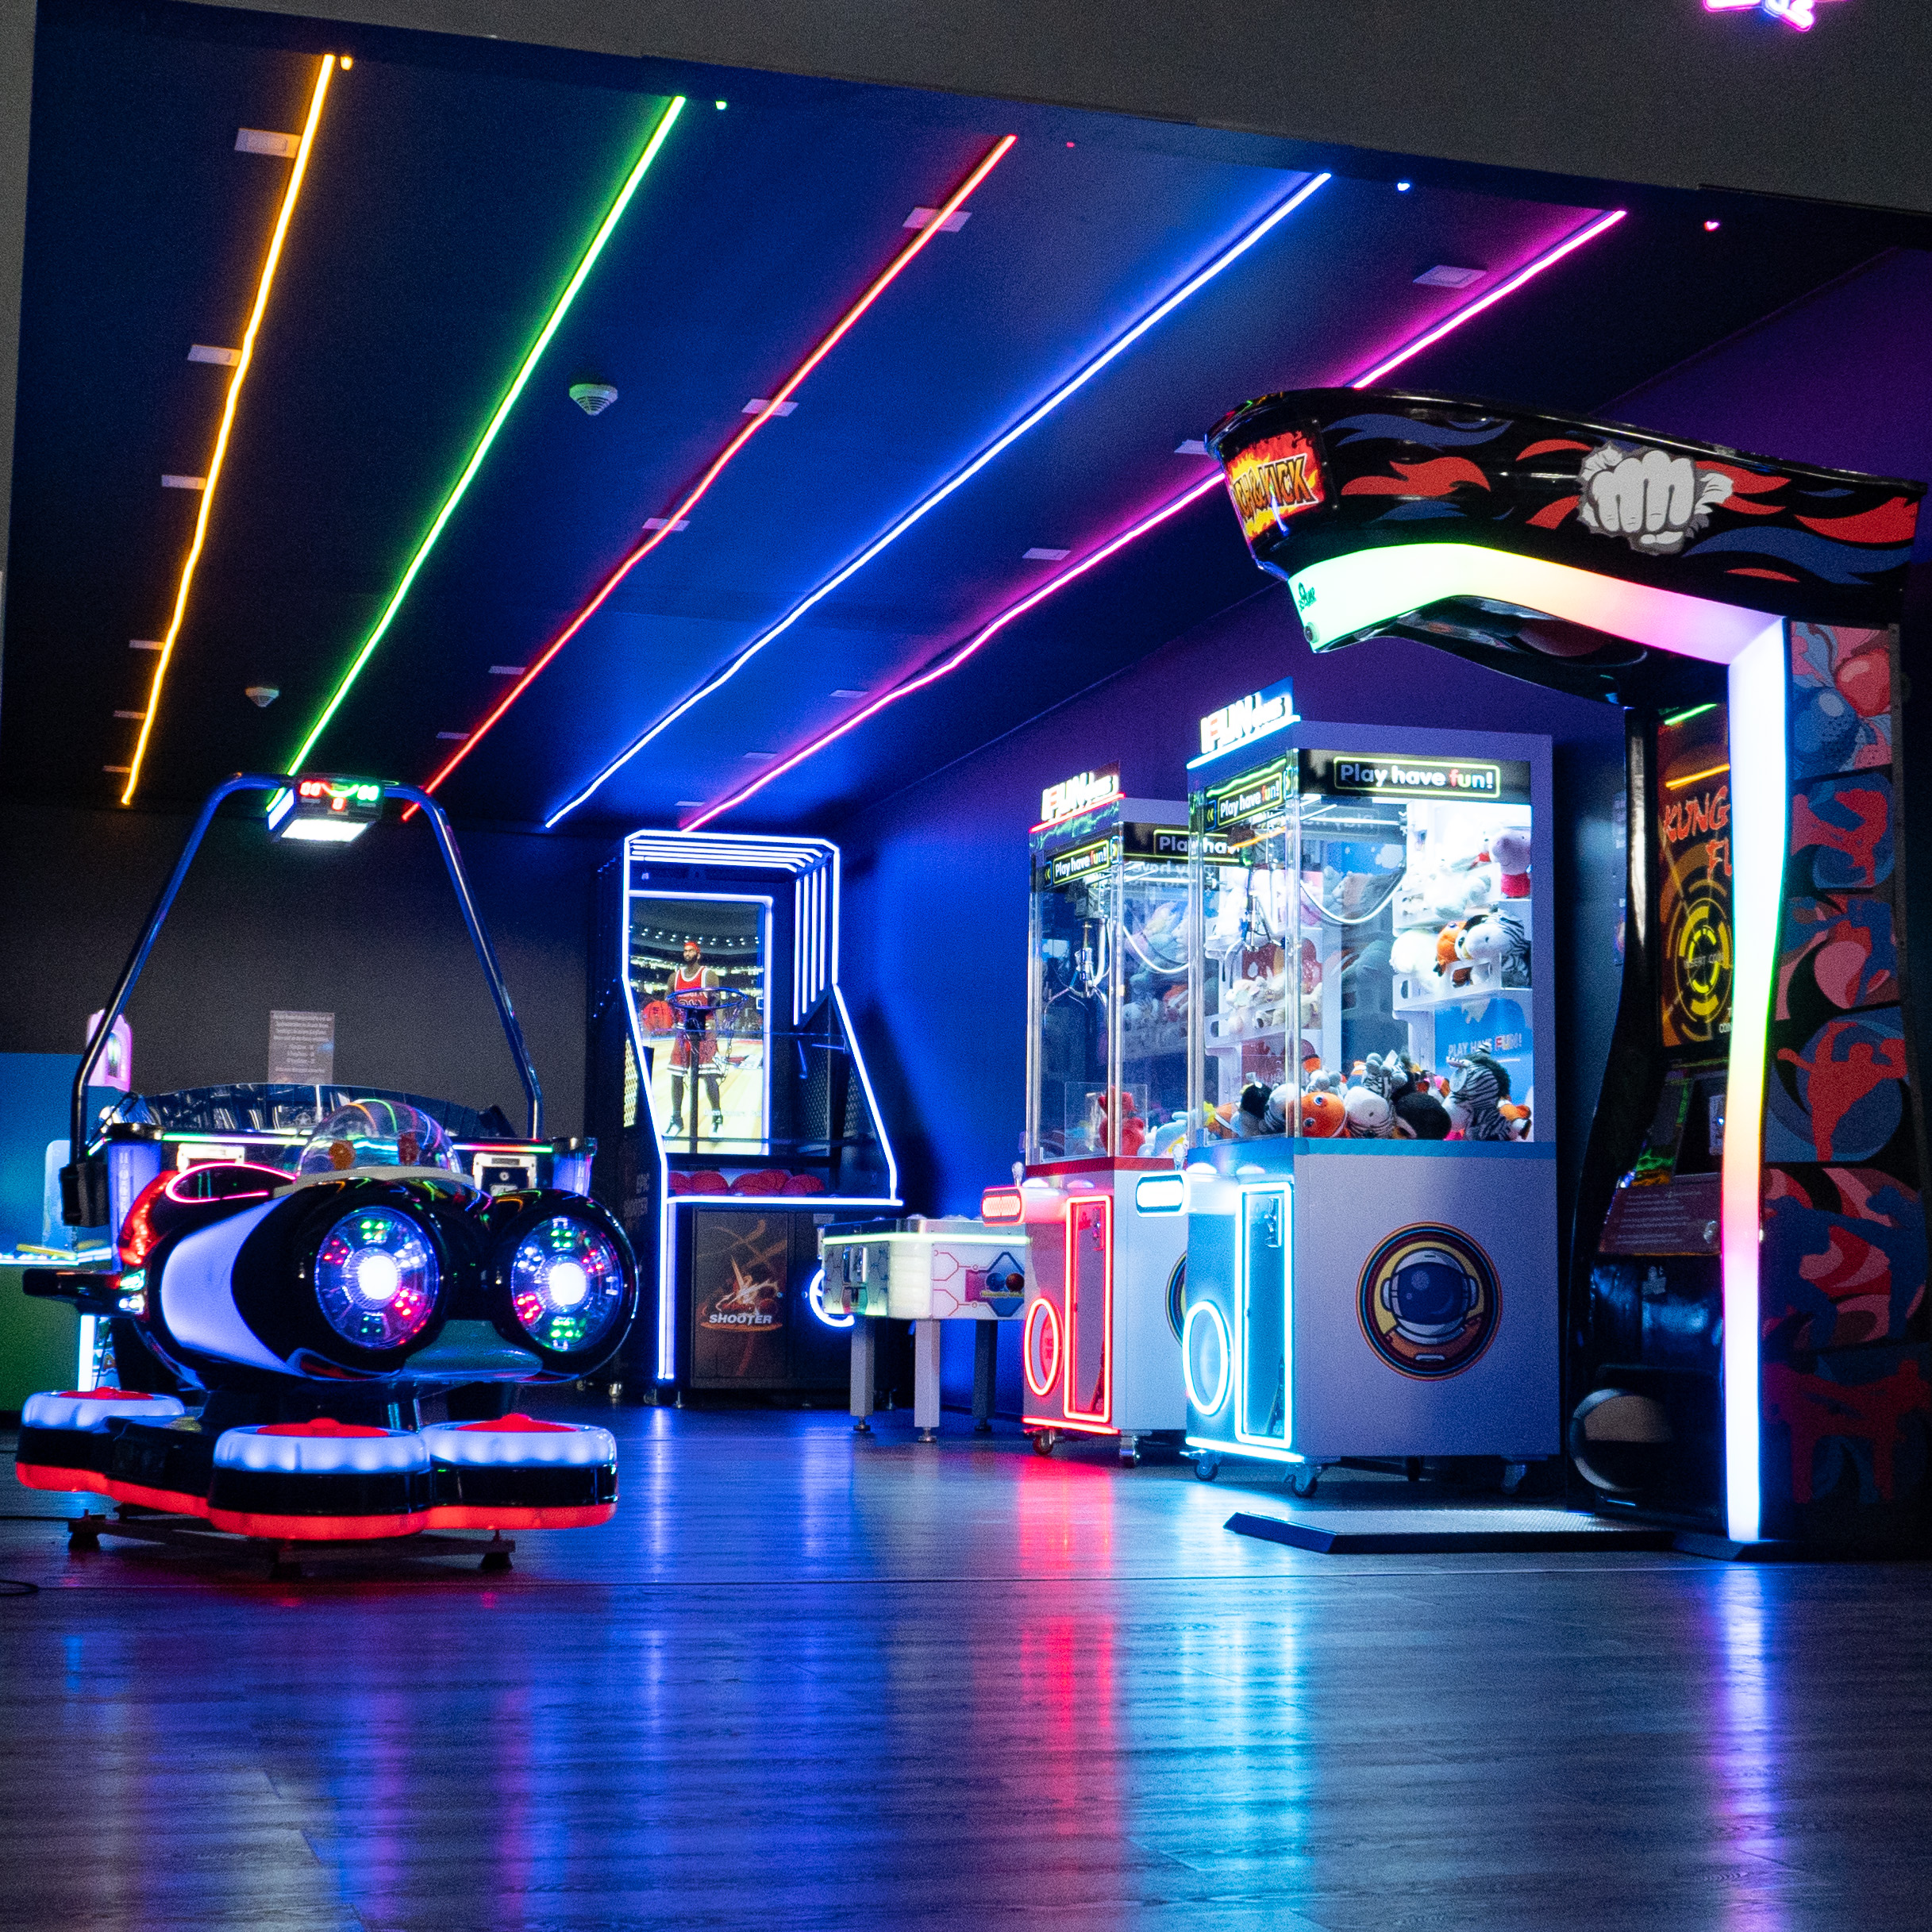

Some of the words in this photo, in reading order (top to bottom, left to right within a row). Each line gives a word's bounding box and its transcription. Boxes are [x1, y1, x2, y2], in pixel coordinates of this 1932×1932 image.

[1341, 764, 1387, 787] Play
[1391, 765, 1445, 786] have
[1449, 768, 1494, 789] fun!
[1220, 800, 1238, 818] Play
[1240, 791, 1261, 810] have
[1261, 780, 1280, 801] fun!
[1664, 786, 1731, 842] KUNG
[1056, 862, 1070, 877] Play
[1071, 856, 1090, 872] have
[1090, 847, 1107, 864] fun!
[1448, 1042, 1468, 1056] PLAY
[709, 1313, 772, 1326] SHOOTER
